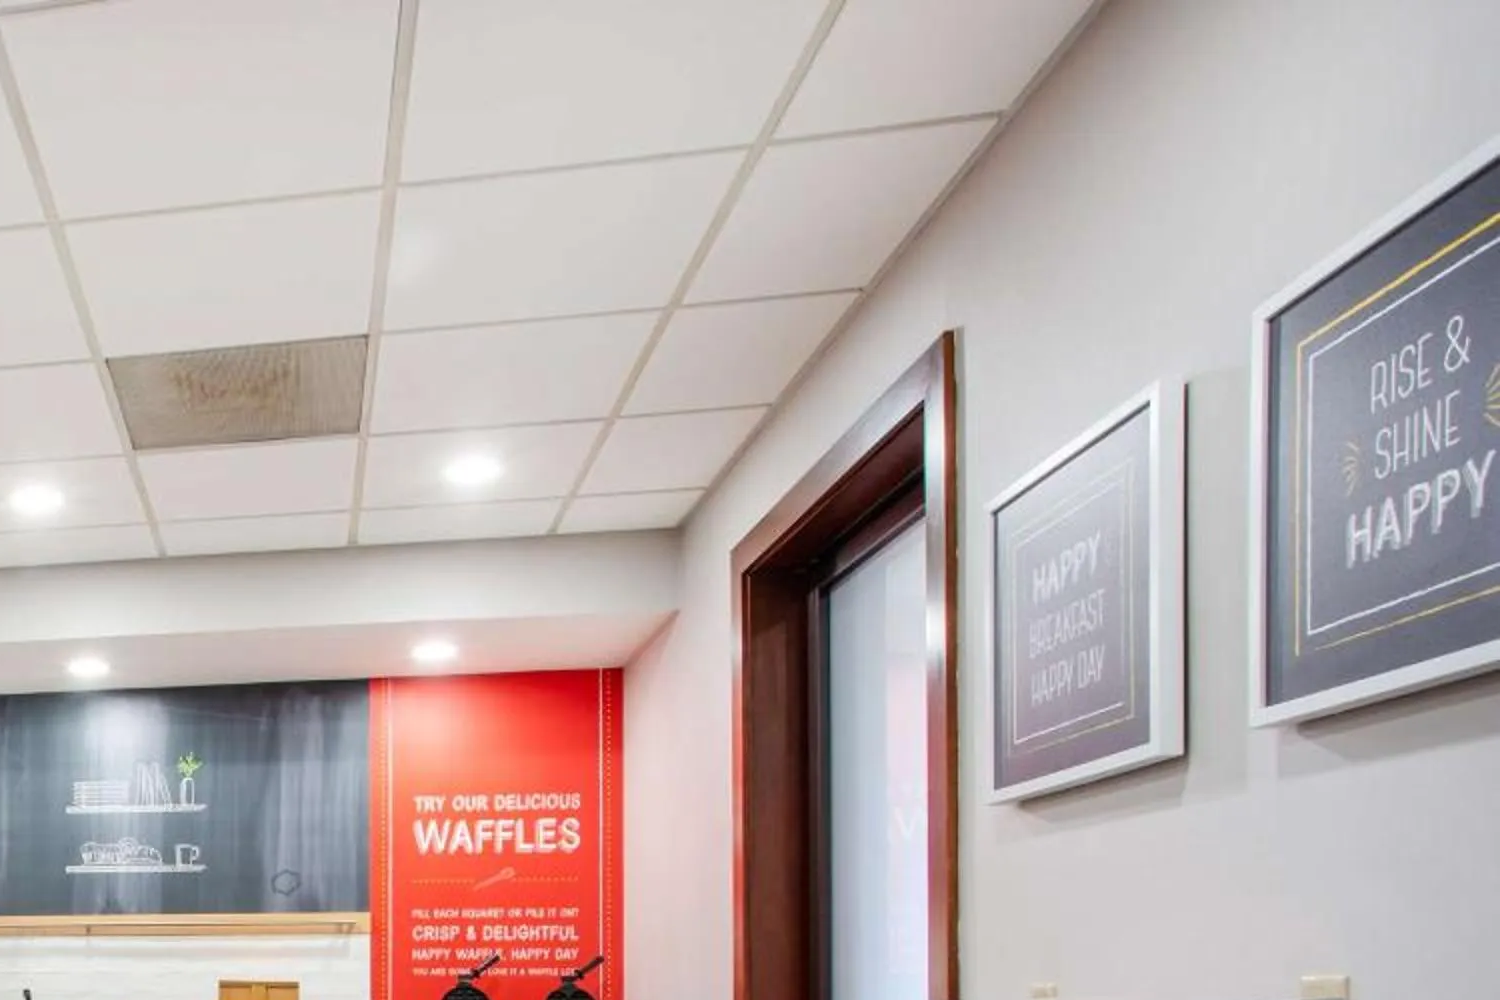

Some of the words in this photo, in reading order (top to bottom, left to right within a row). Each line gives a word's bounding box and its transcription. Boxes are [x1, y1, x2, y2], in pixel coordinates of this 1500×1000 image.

[1371, 332, 1433, 415] RISE
[1443, 314, 1471, 373] &
[1374, 389, 1461, 480] SHINE
[1346, 448, 1497, 569] HAPPY
[1032, 530, 1100, 605] HAPPY
[1028, 587, 1105, 660] BREAKFAST
[1030, 657, 1074, 707] HAPPY
[1077, 644, 1105, 690] DAY
[412, 816, 581, 855] WAFFLES
[414, 796, 446, 813] TRY
[452, 794, 489, 812] OUR
[494, 792, 581, 812] DELICIOUS
[411, 925, 460, 942] CRISP
[466, 925, 477, 941] &
[482, 924, 580, 942] DELIGHTFUL
[411, 947, 452, 961] HAPPY
[511, 947, 550, 961] HAPPY
[555, 947, 580, 961] DAY
